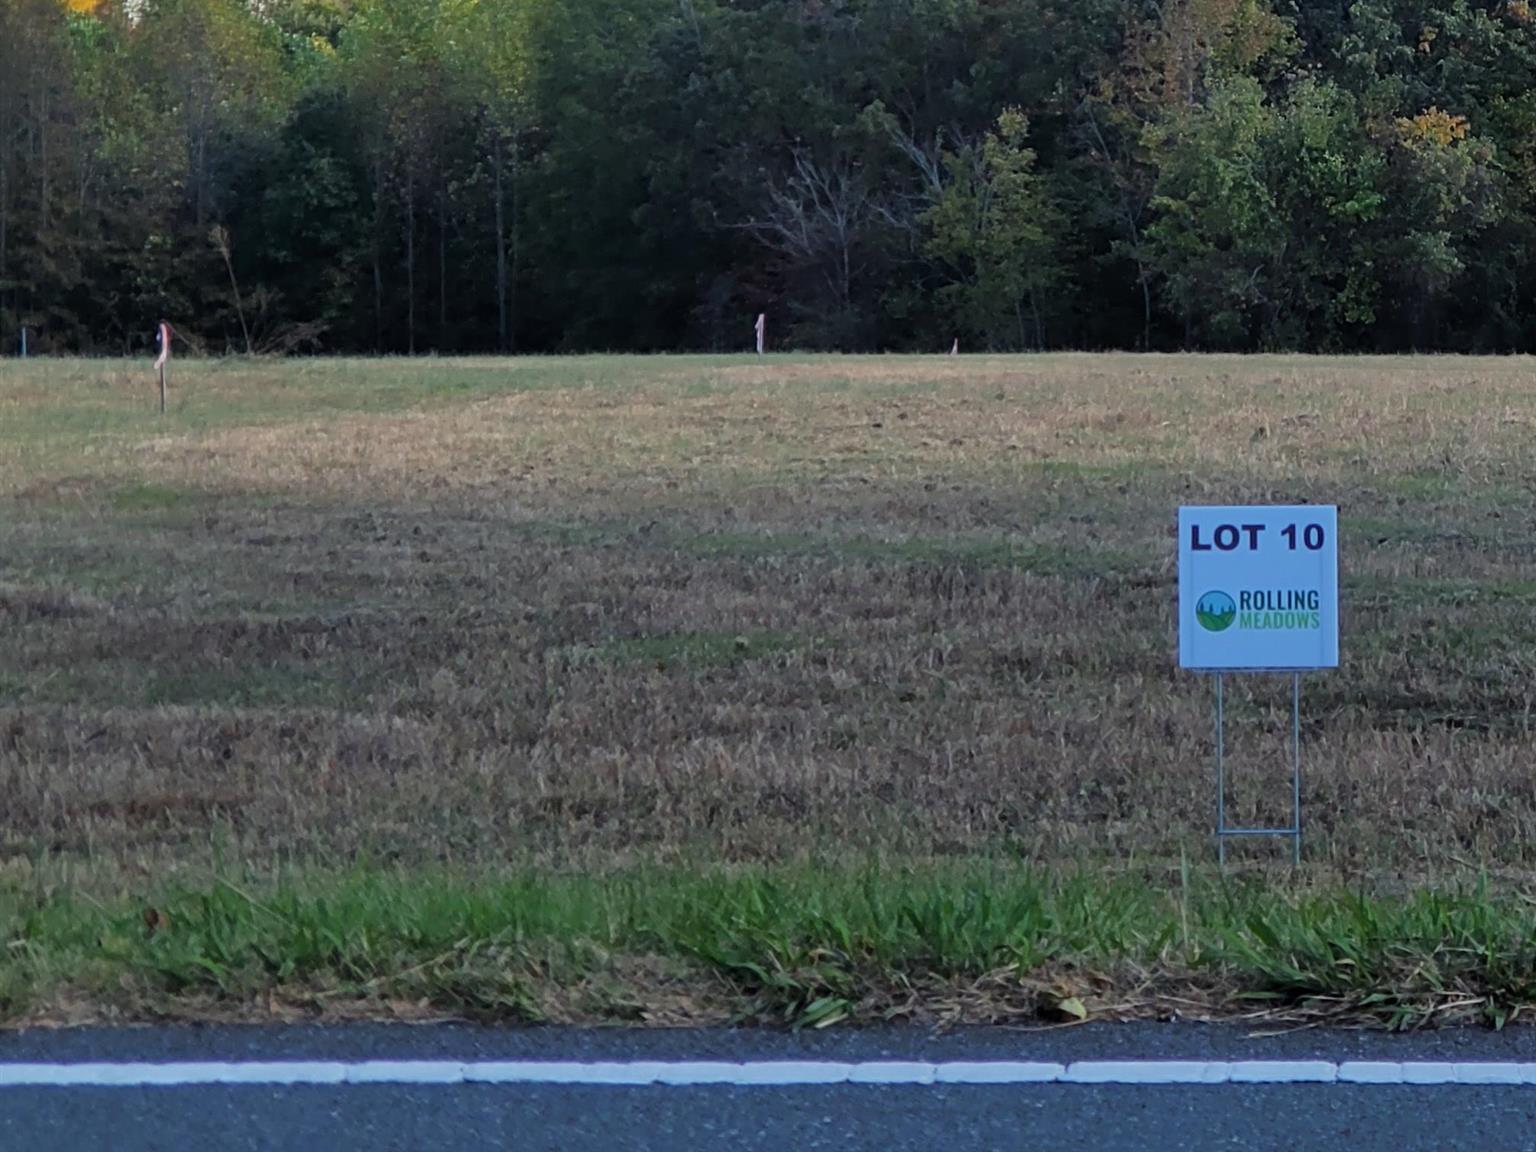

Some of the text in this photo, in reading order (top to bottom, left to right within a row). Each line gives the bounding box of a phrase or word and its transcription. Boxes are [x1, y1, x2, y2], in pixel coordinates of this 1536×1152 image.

[1191, 523, 1325, 550] LOT 10
[1240, 590, 1319, 610] ROLLING
[1240, 612, 1320, 629] MEADOWS
